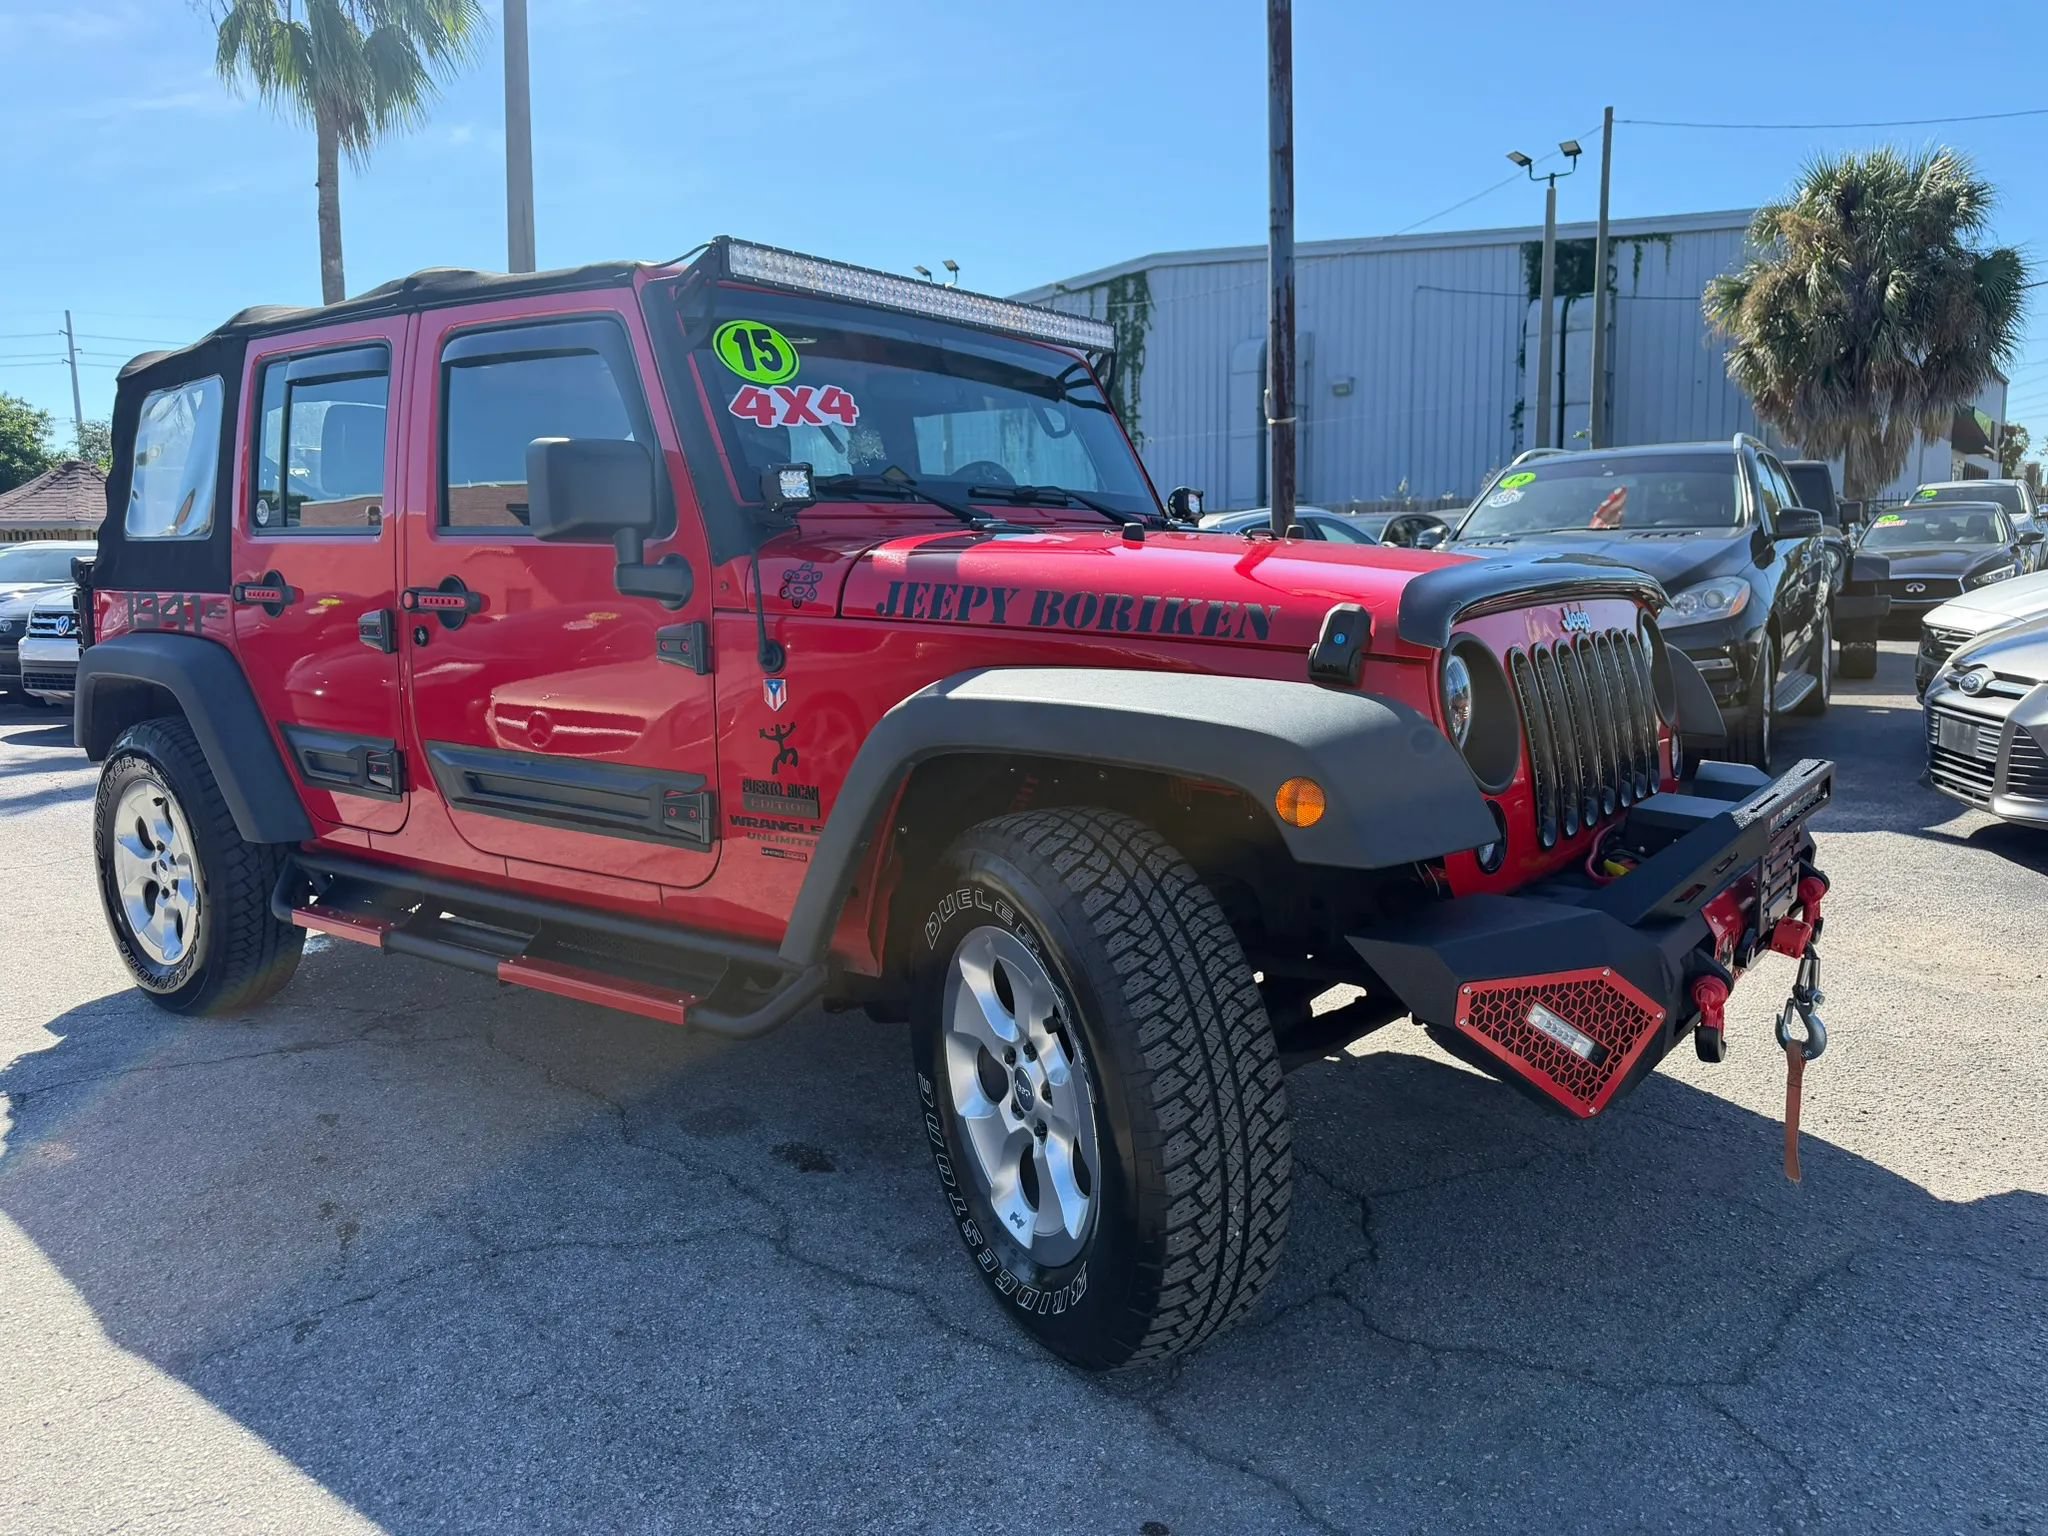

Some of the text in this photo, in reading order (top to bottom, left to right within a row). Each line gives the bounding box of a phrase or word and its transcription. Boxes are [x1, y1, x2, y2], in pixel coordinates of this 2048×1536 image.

[733, 328, 783, 372] 15
[730, 386, 858, 426] 4X4
[876, 581, 1282, 641] JEEPY BORIKEN
[1561, 607, 1591, 634] Jeep
[730, 815, 825, 834] WRANGLE
[747, 832, 818, 848] UNLIMITE
[925, 888, 1041, 954] DUELER
[918, 1073, 1087, 1315] BRIDGESTONE
